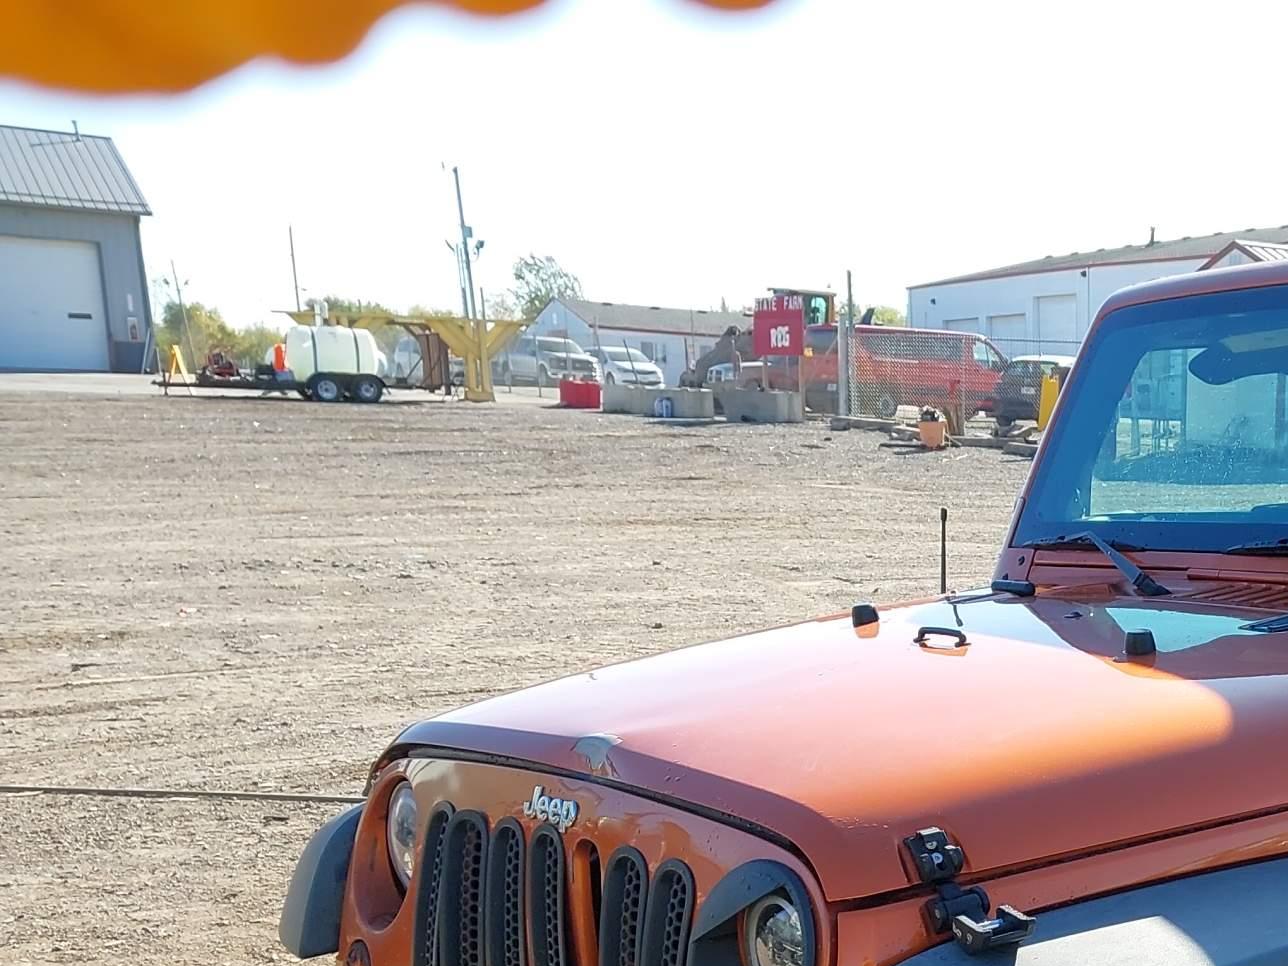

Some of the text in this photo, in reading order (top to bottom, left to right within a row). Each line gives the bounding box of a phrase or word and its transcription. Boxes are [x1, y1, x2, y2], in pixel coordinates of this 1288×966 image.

[754, 295, 802, 311] STATE FARM
[523, 785, 578, 833] Jeep
